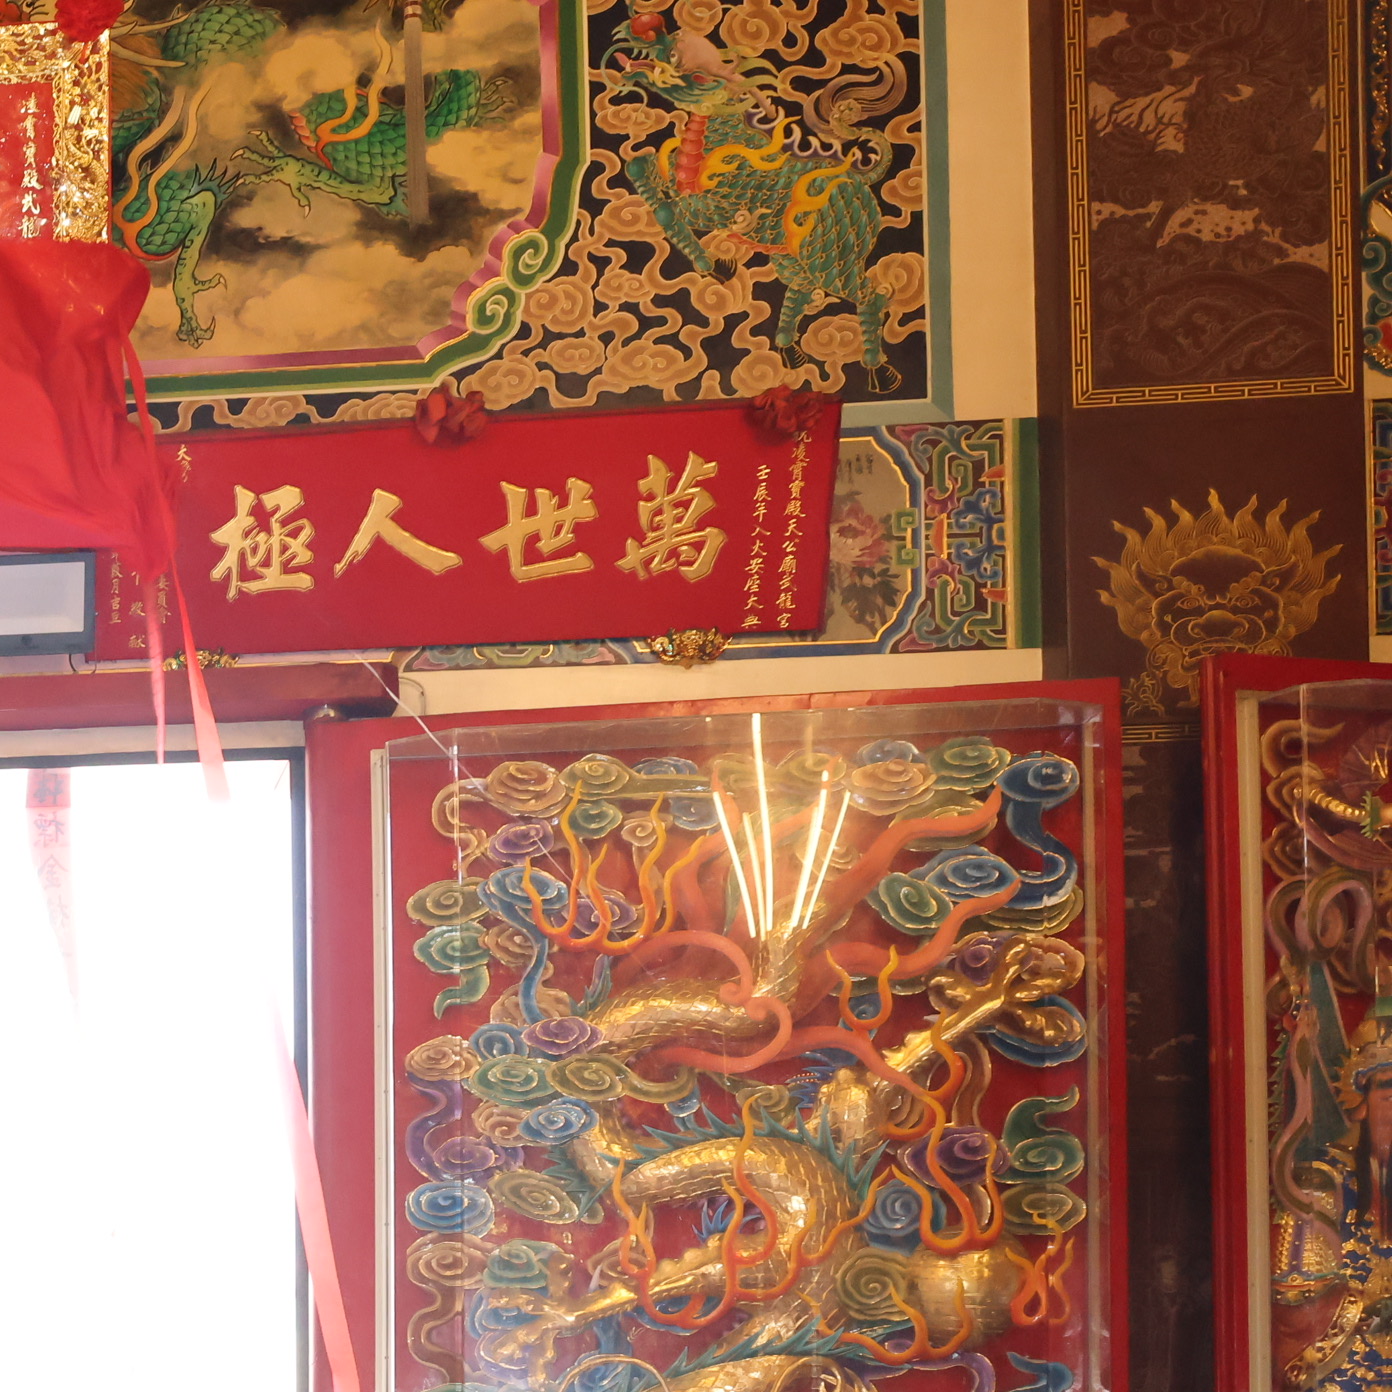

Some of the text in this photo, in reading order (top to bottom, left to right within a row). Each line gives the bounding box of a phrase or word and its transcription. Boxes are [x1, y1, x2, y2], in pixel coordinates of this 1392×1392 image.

[209, 450, 728, 603] 萬世人極
[741, 464, 772, 630] 壬辰年入火安座大典
